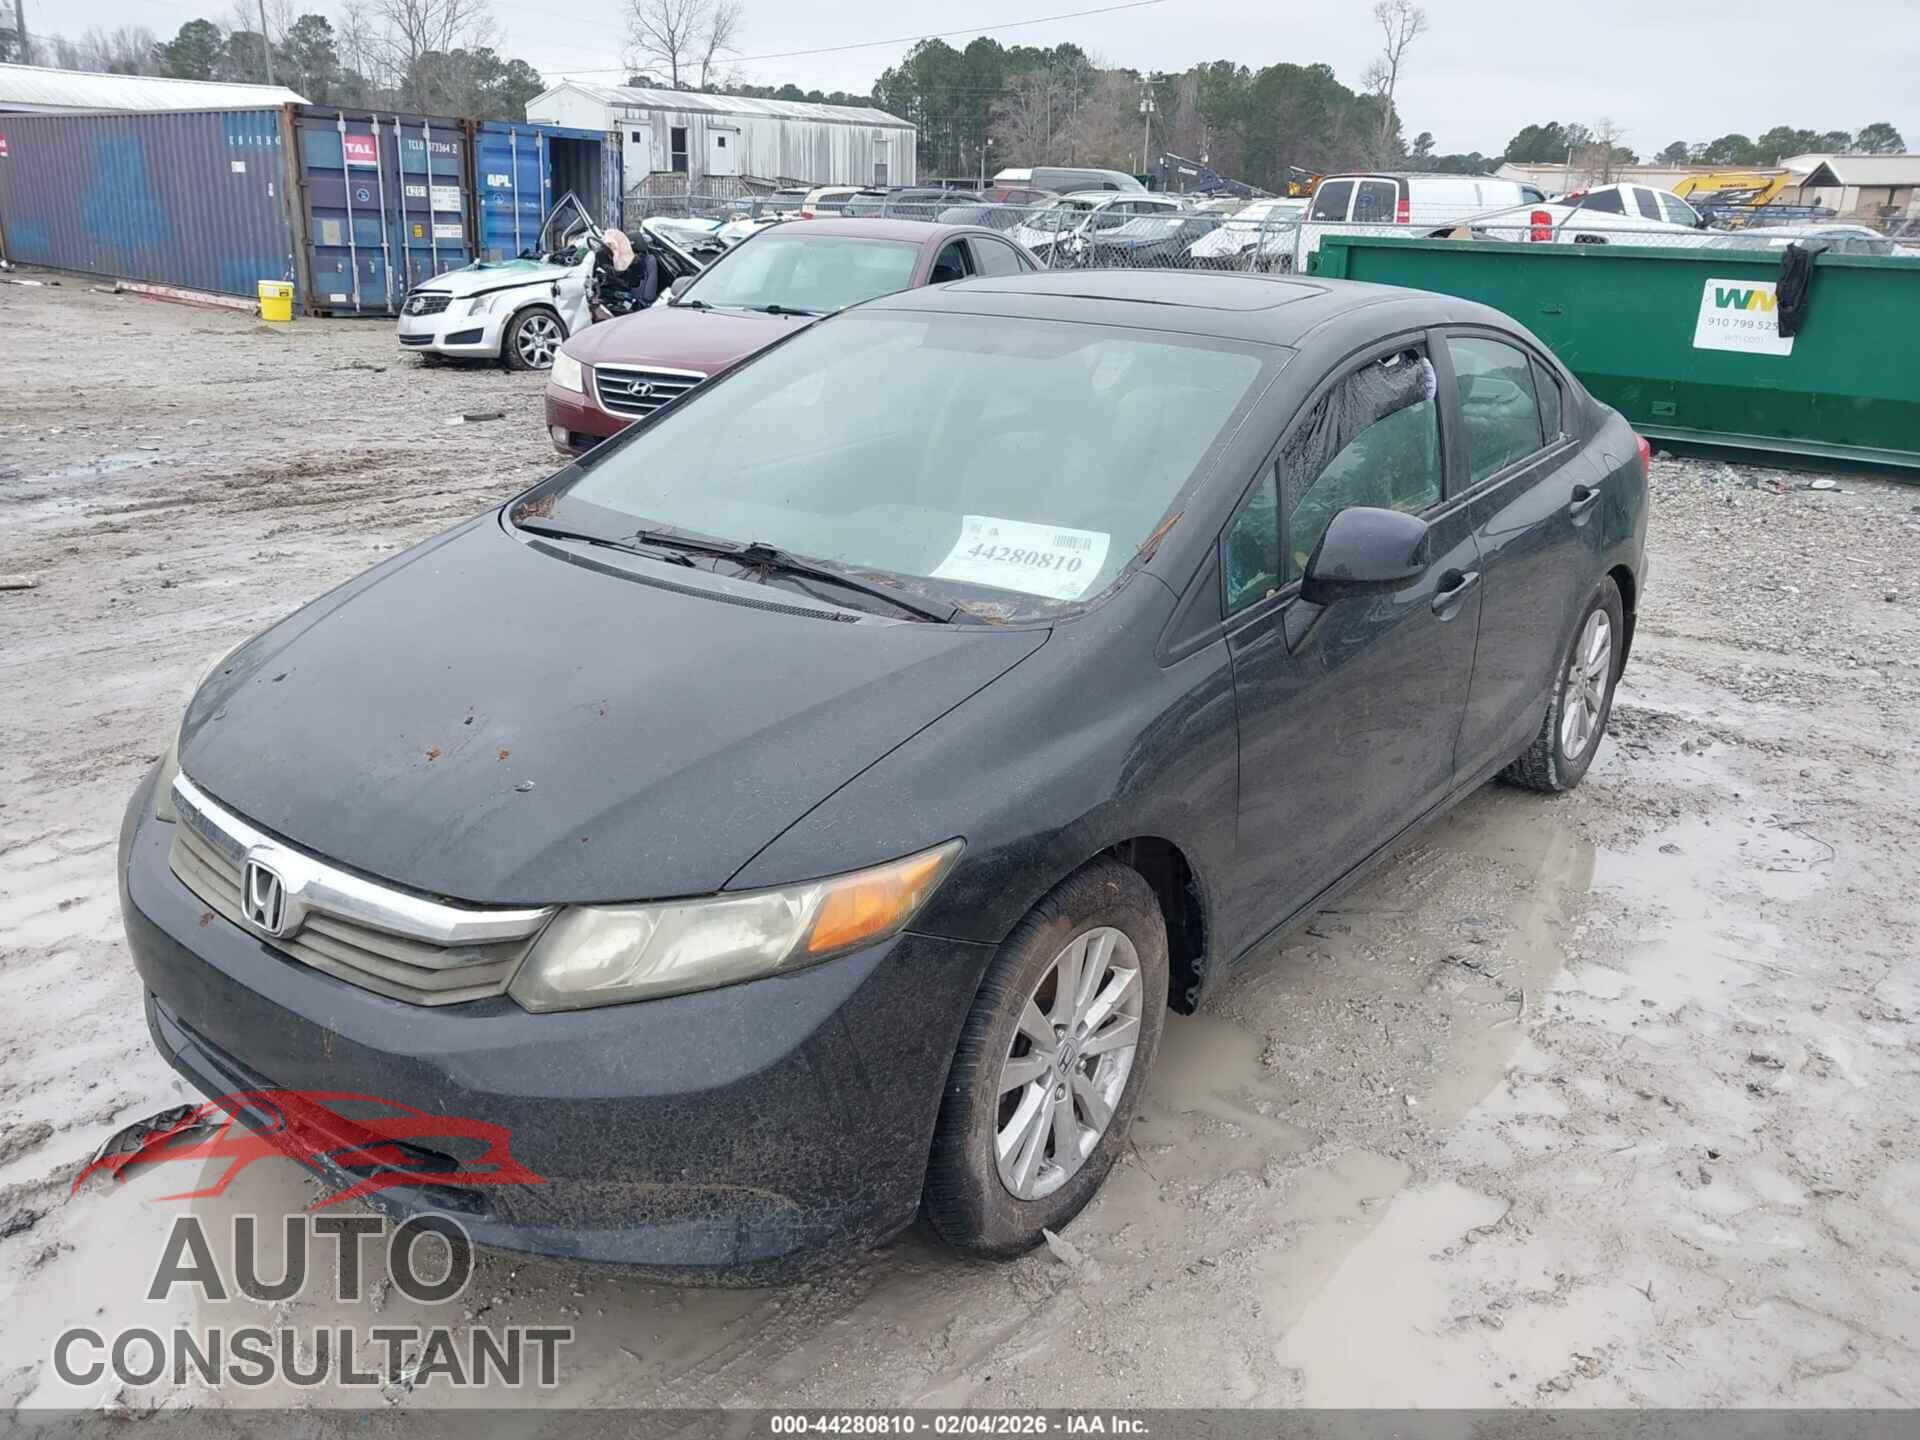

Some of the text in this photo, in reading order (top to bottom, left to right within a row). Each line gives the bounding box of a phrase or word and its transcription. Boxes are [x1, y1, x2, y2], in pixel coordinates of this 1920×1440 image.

[345, 143, 375, 154] TAL
[487, 174, 512, 188] APL
[1708, 317, 1780, 331] 910 799 525
[967, 543, 1083, 573] 44280810
